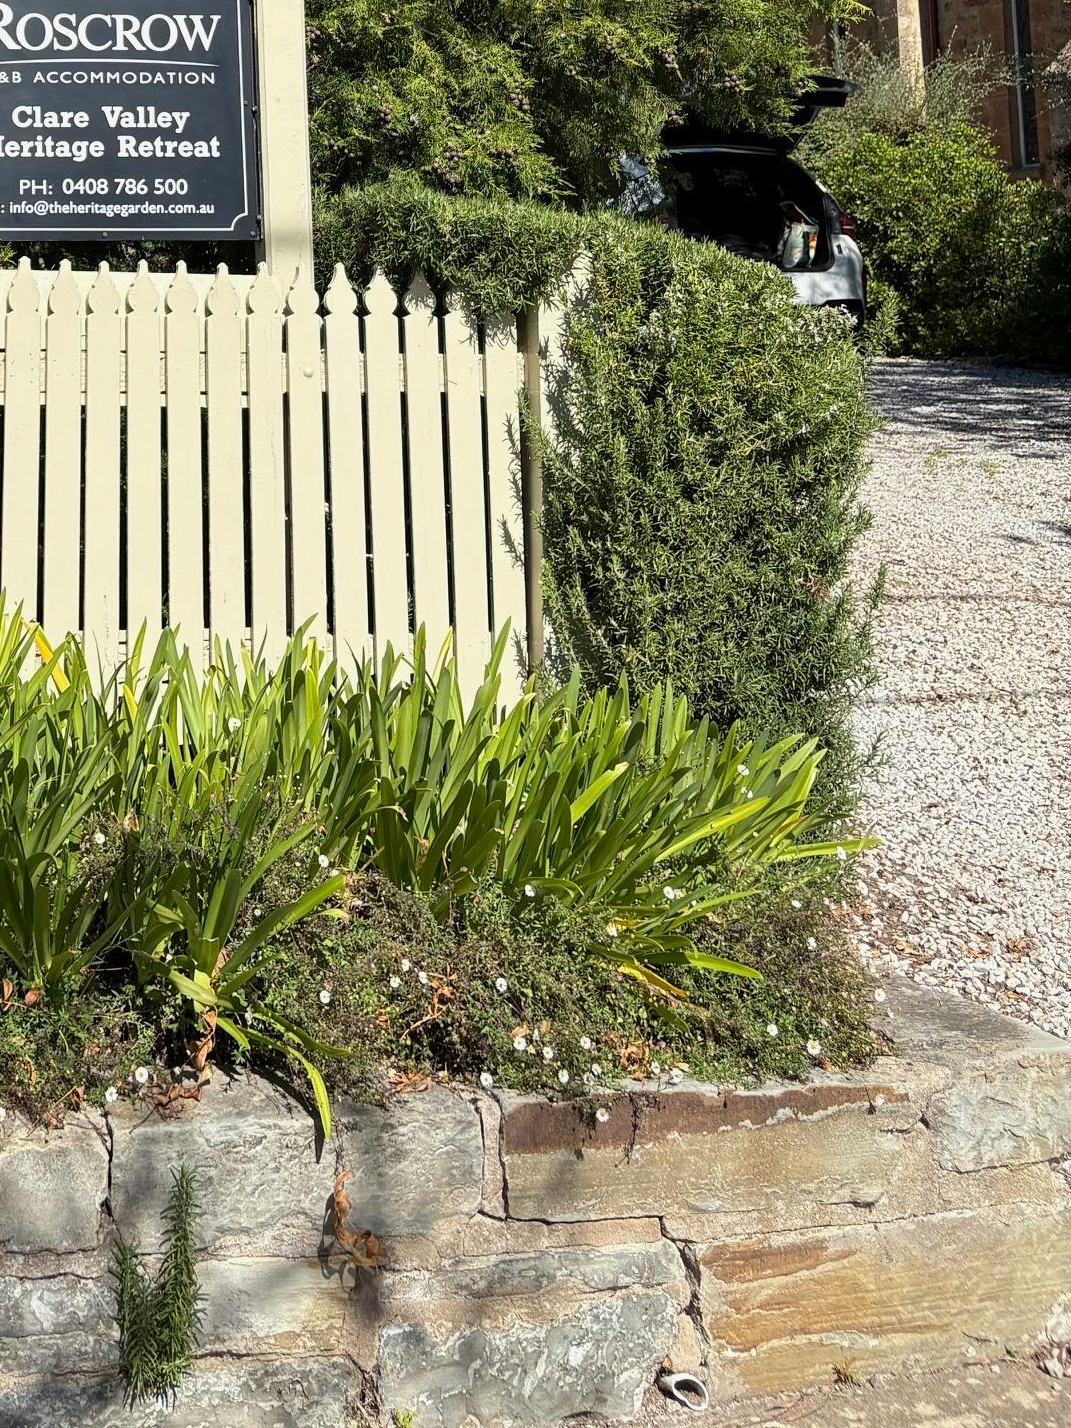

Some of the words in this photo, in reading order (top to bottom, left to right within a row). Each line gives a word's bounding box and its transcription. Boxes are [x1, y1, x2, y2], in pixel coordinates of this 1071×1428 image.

[33, 71, 215, 85] ACCOMMODATION
[12, 106, 90, 128] Clare
[101, 106, 190, 133] Valley
[117, 135, 221, 158] Retreat
[19, 178, 53, 195] PH:
[62, 178, 109, 195] 0408
[114, 178, 149, 195] 786
[154, 178, 189, 195] 500
[9, 200, 215, 217] info@theheritagegarden.com.au
